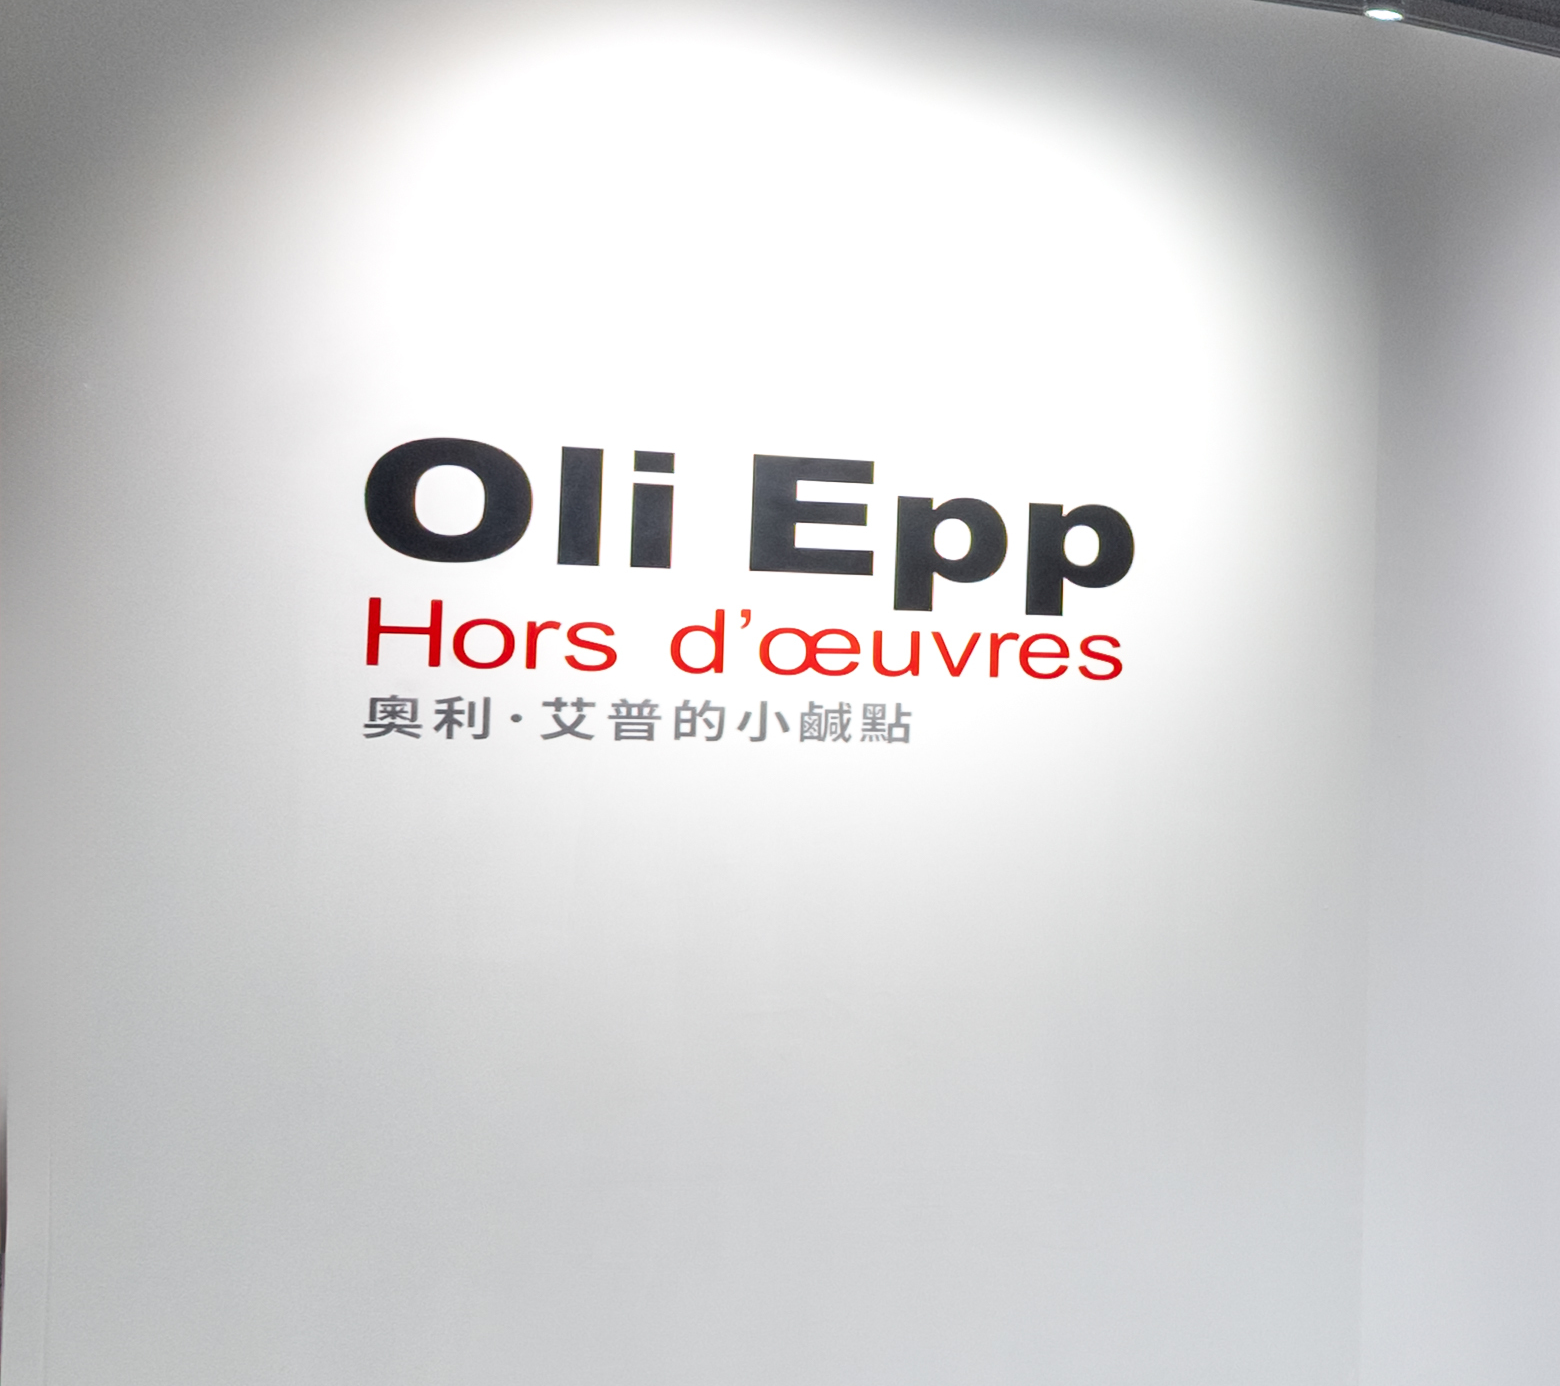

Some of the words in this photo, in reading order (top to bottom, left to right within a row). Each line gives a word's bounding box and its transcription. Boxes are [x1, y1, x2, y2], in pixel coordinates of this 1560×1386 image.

[364, 437, 675, 570] Oli
[748, 453, 1135, 617] Epp
[365, 596, 618, 672] Hors
